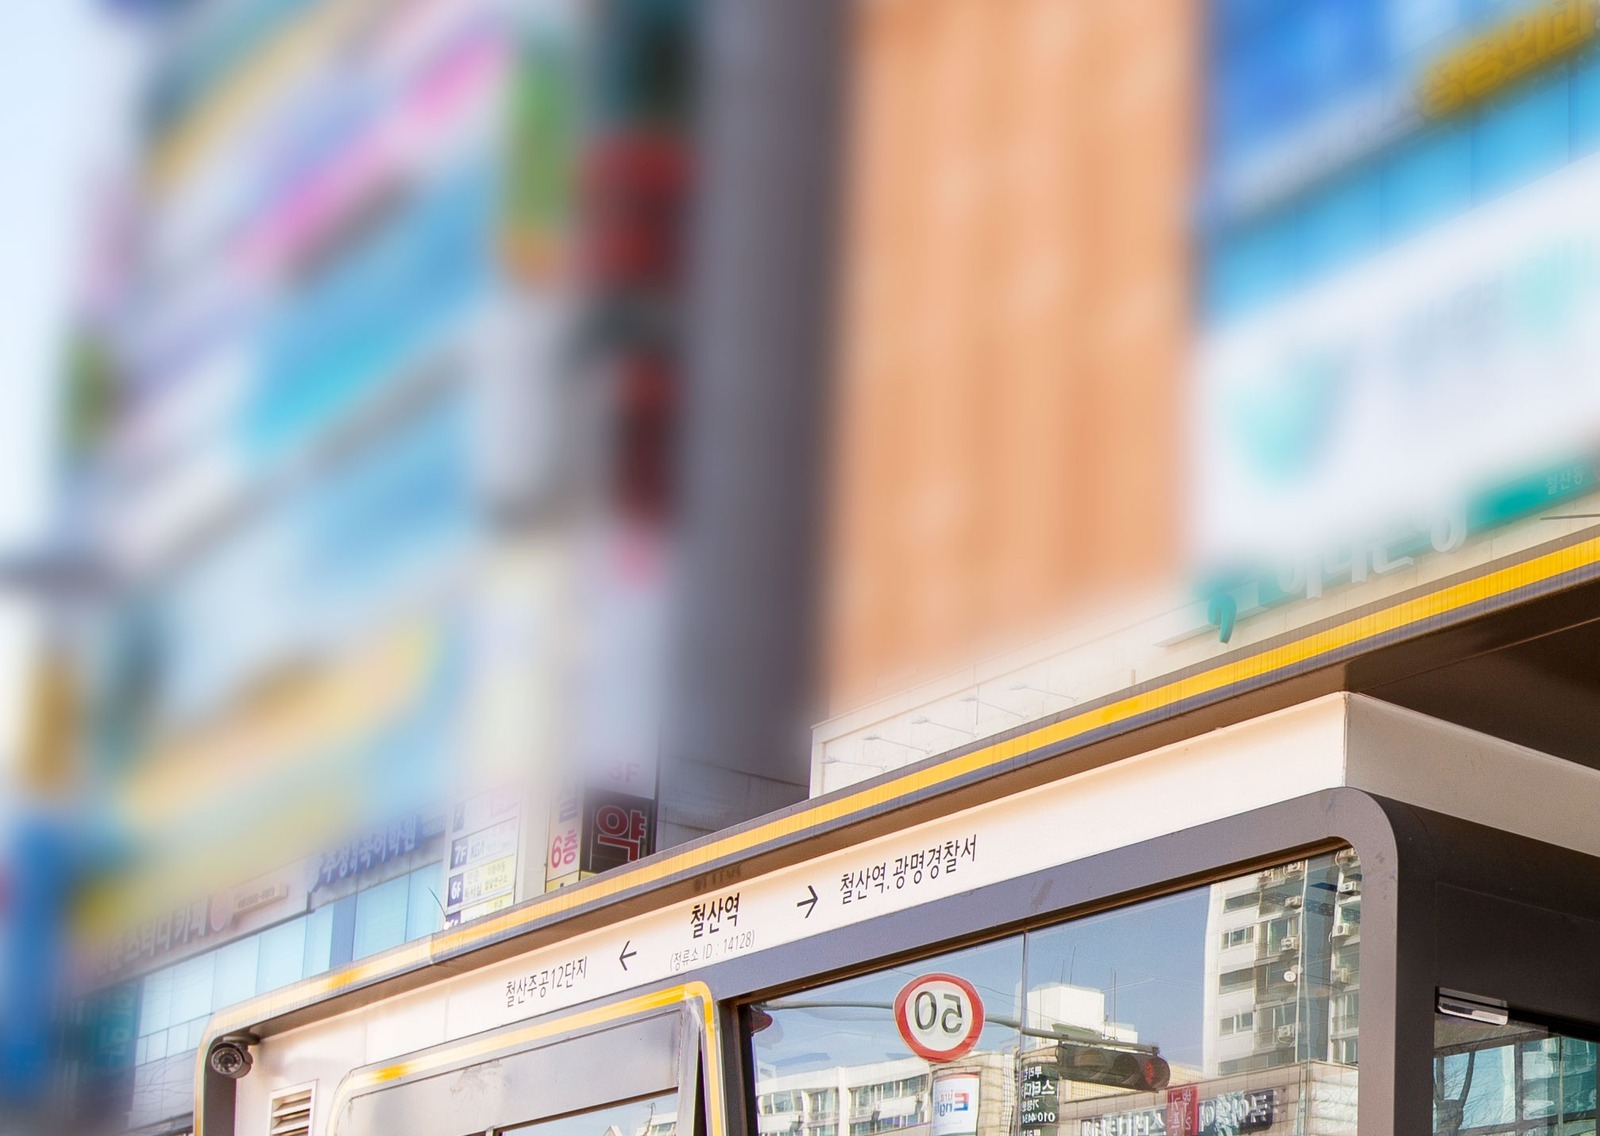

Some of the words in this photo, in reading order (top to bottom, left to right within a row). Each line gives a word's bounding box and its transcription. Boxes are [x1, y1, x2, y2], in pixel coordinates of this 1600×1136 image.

[551, 829, 578, 869] 6층
[596, 805, 648, 862] 약
[454, 844, 466, 864] 7F
[451, 879, 462, 900] 6F
[690, 892, 741, 939] 철산역
[723, 930, 756, 951] 14128)
[506, 956, 588, 1008] 철산주공12단지
